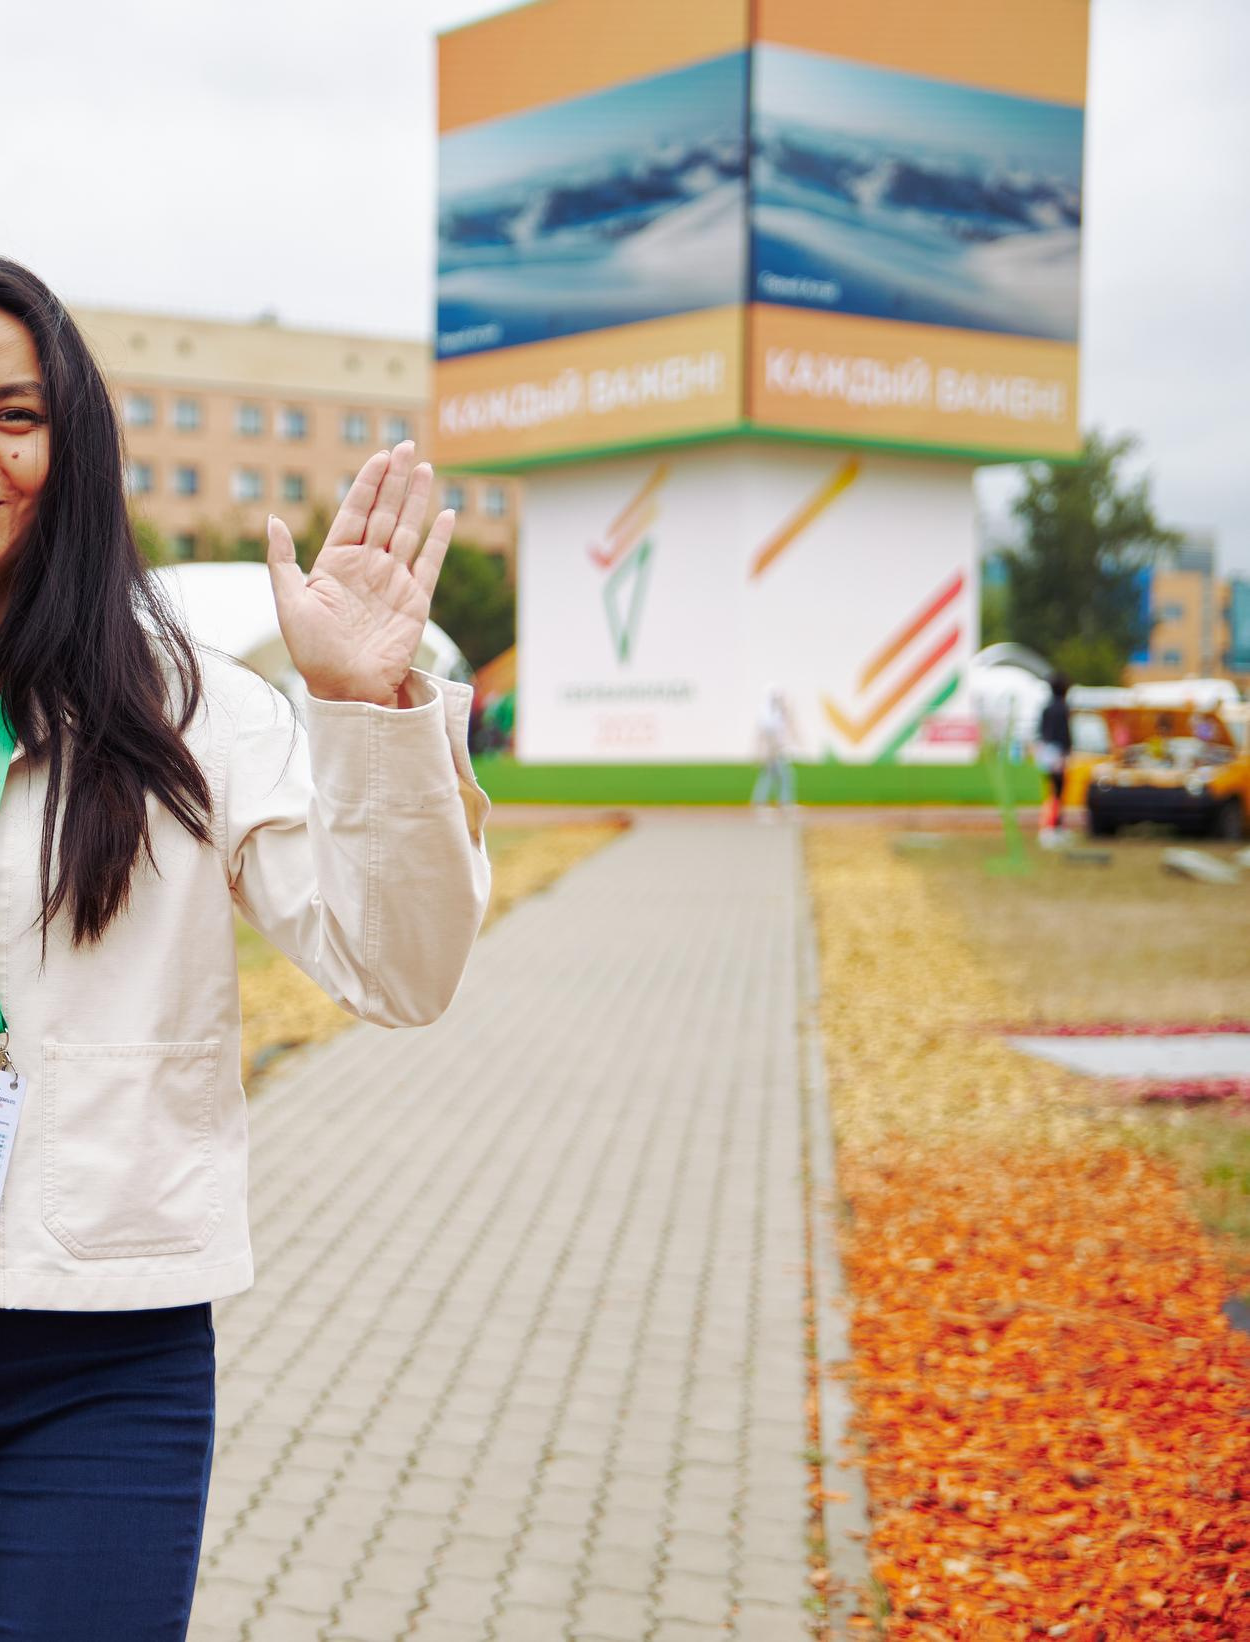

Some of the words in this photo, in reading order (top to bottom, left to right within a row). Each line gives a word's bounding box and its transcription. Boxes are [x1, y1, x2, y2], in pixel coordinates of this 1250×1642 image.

[439, 367, 584, 434] КАЖДЫЙ
[588, 351, 725, 414] ВАЖЕН!
[765, 347, 933, 408] КАЖДЫЙ
[936, 367, 1067, 423] ВАЖЕН!
